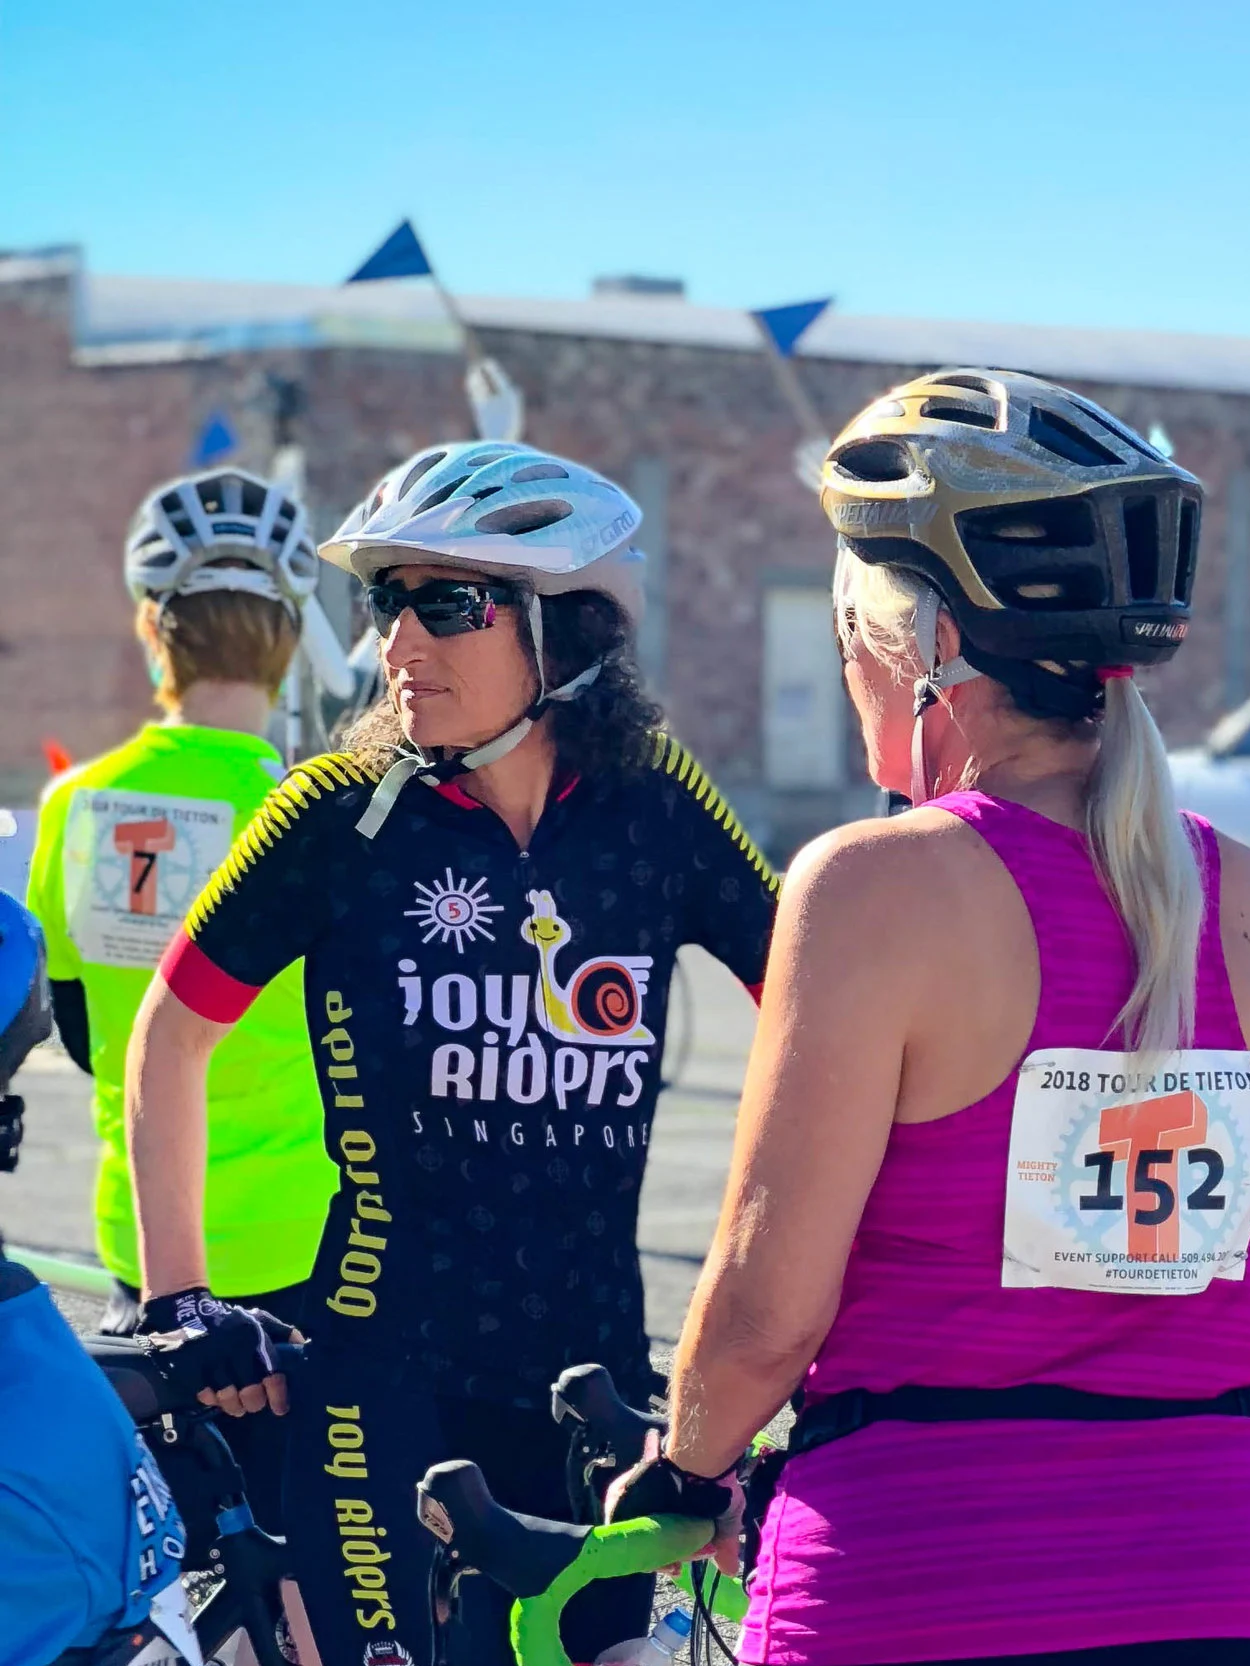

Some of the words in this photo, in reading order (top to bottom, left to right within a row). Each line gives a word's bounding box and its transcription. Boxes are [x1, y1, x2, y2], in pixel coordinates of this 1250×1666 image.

[133, 850, 157, 894] 7
[1040, 1070, 1091, 1092] 2018
[1163, 1072, 1191, 1092] DE
[1017, 1160, 1058, 1171] MIGHTY
[1018, 1172, 1056, 1182] TIETON
[1079, 1148, 1226, 1227] 152
[1054, 1251, 1093, 1263] EVENT
[1095, 1252, 1150, 1263] SUPPORT
[1151, 1253, 1179, 1264] CALL
[1105, 1268, 1198, 1280] #TOURDETIETON
